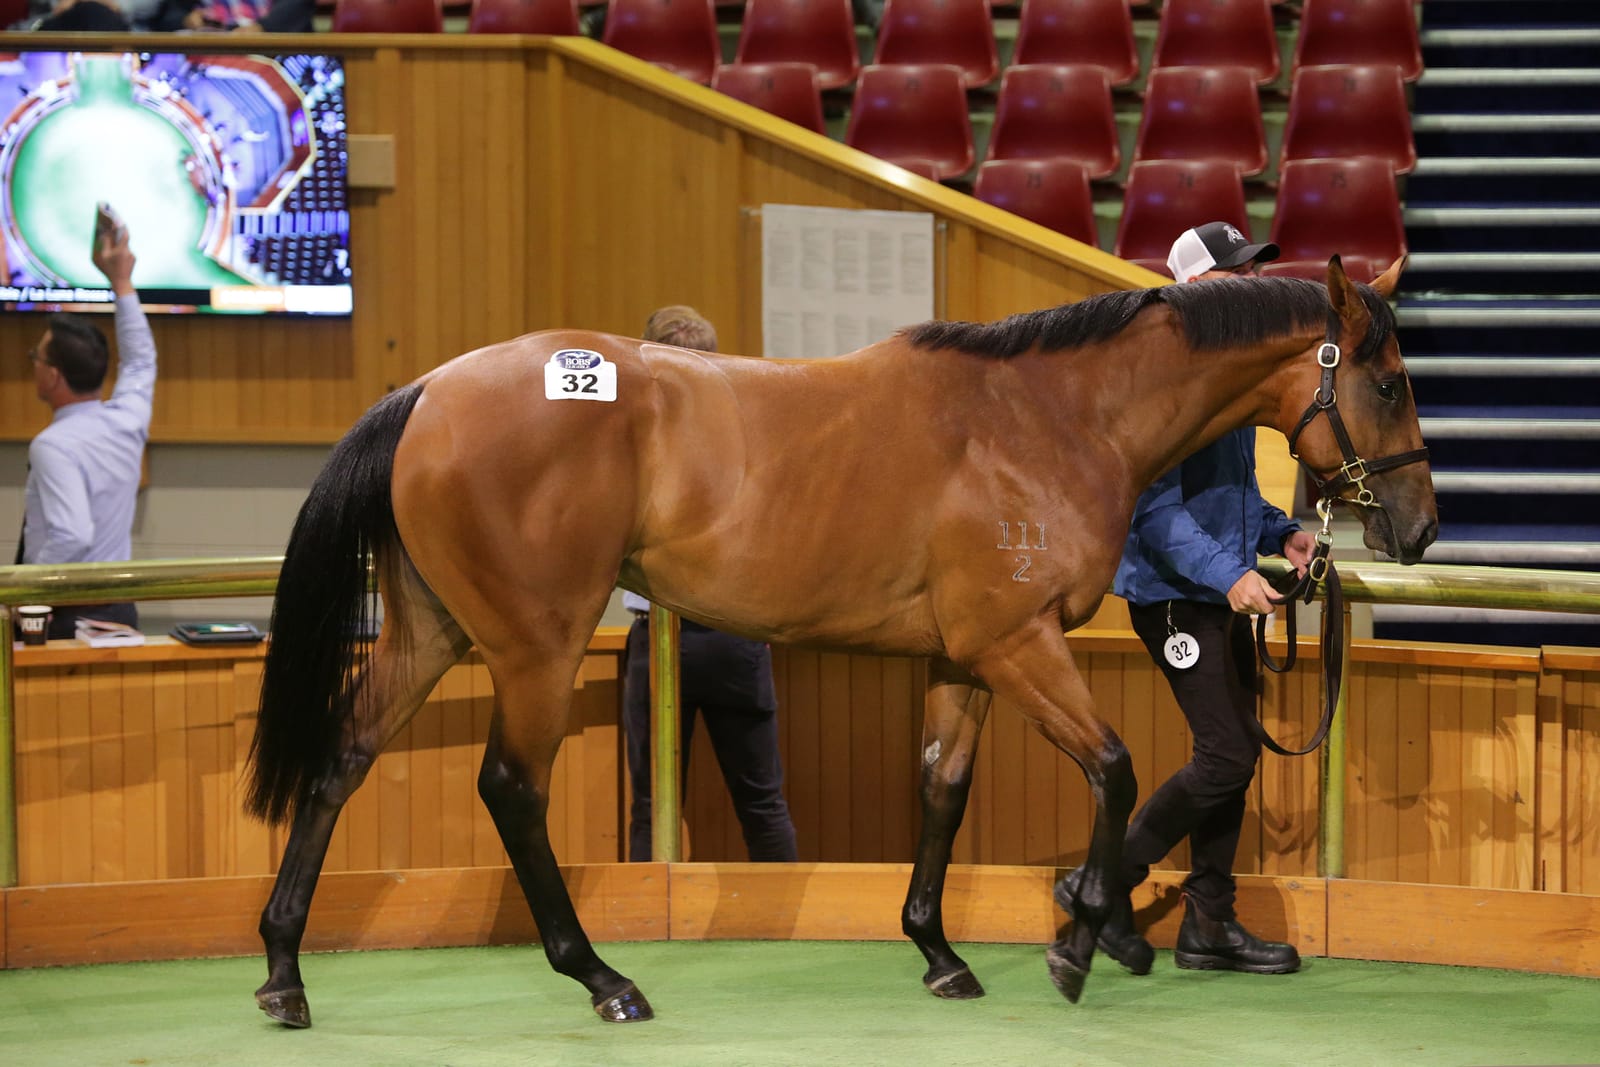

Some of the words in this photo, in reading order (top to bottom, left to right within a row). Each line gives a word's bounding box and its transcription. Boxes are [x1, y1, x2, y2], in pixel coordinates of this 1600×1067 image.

[565, 358, 591, 366] BOBS
[562, 374, 598, 393] 32
[997, 521, 1047, 550] 111
[1012, 554, 1031, 581] 2
[1171, 641, 1192, 661] 32
